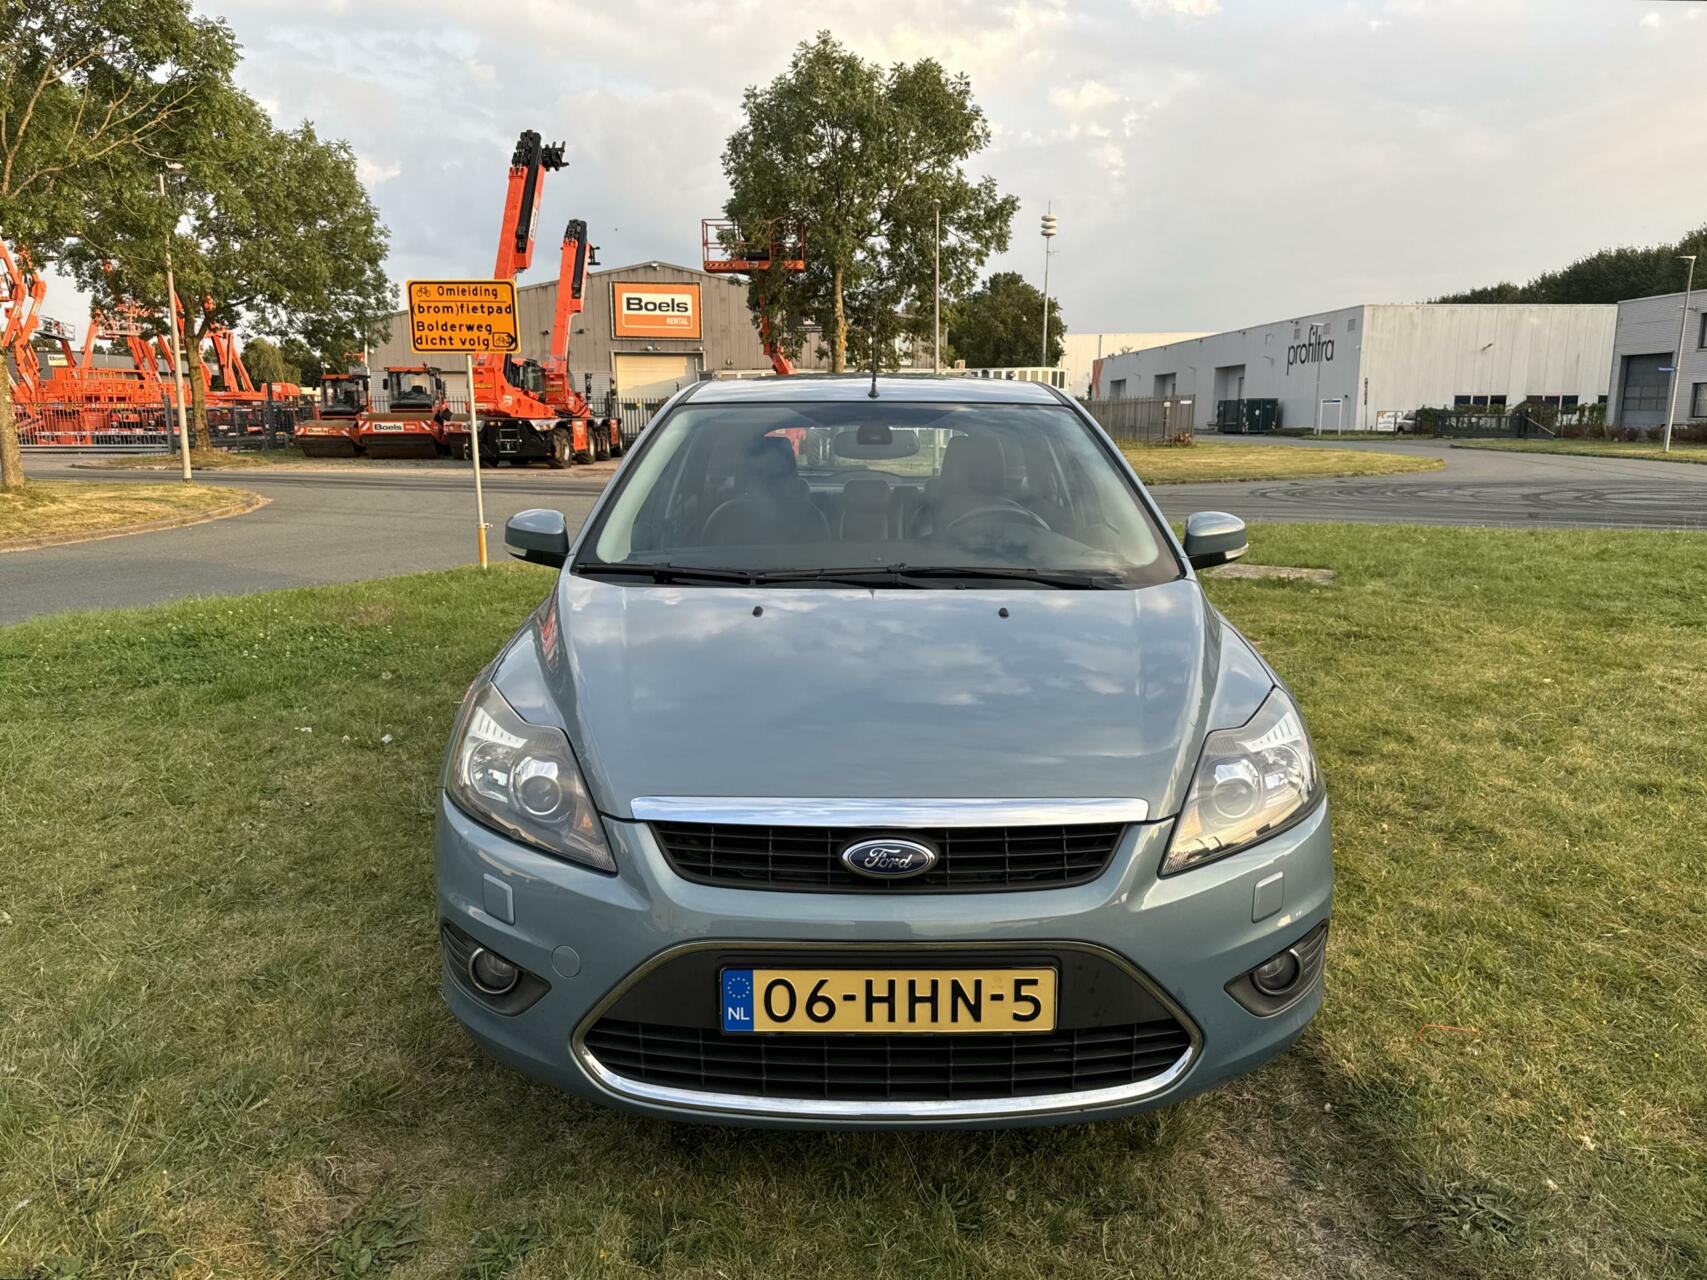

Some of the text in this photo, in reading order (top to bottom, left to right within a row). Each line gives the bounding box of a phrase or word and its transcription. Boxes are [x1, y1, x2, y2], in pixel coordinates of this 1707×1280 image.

[437, 286, 498, 299] Omleiding
[413, 303, 512, 316] (brom)fietpad
[626, 297, 689, 312] Boels
[416, 321, 492, 335] Bolderweg
[666, 317, 689, 325] RENTAL
[415, 335, 490, 349] dicht volg
[1287, 325, 1334, 376] profiltra
[374, 423, 402, 431] Boels
[864, 847, 913, 869] Ford
[763, 978, 1042, 1023] 06-HHN-5
[727, 1007, 750, 1021] NL
